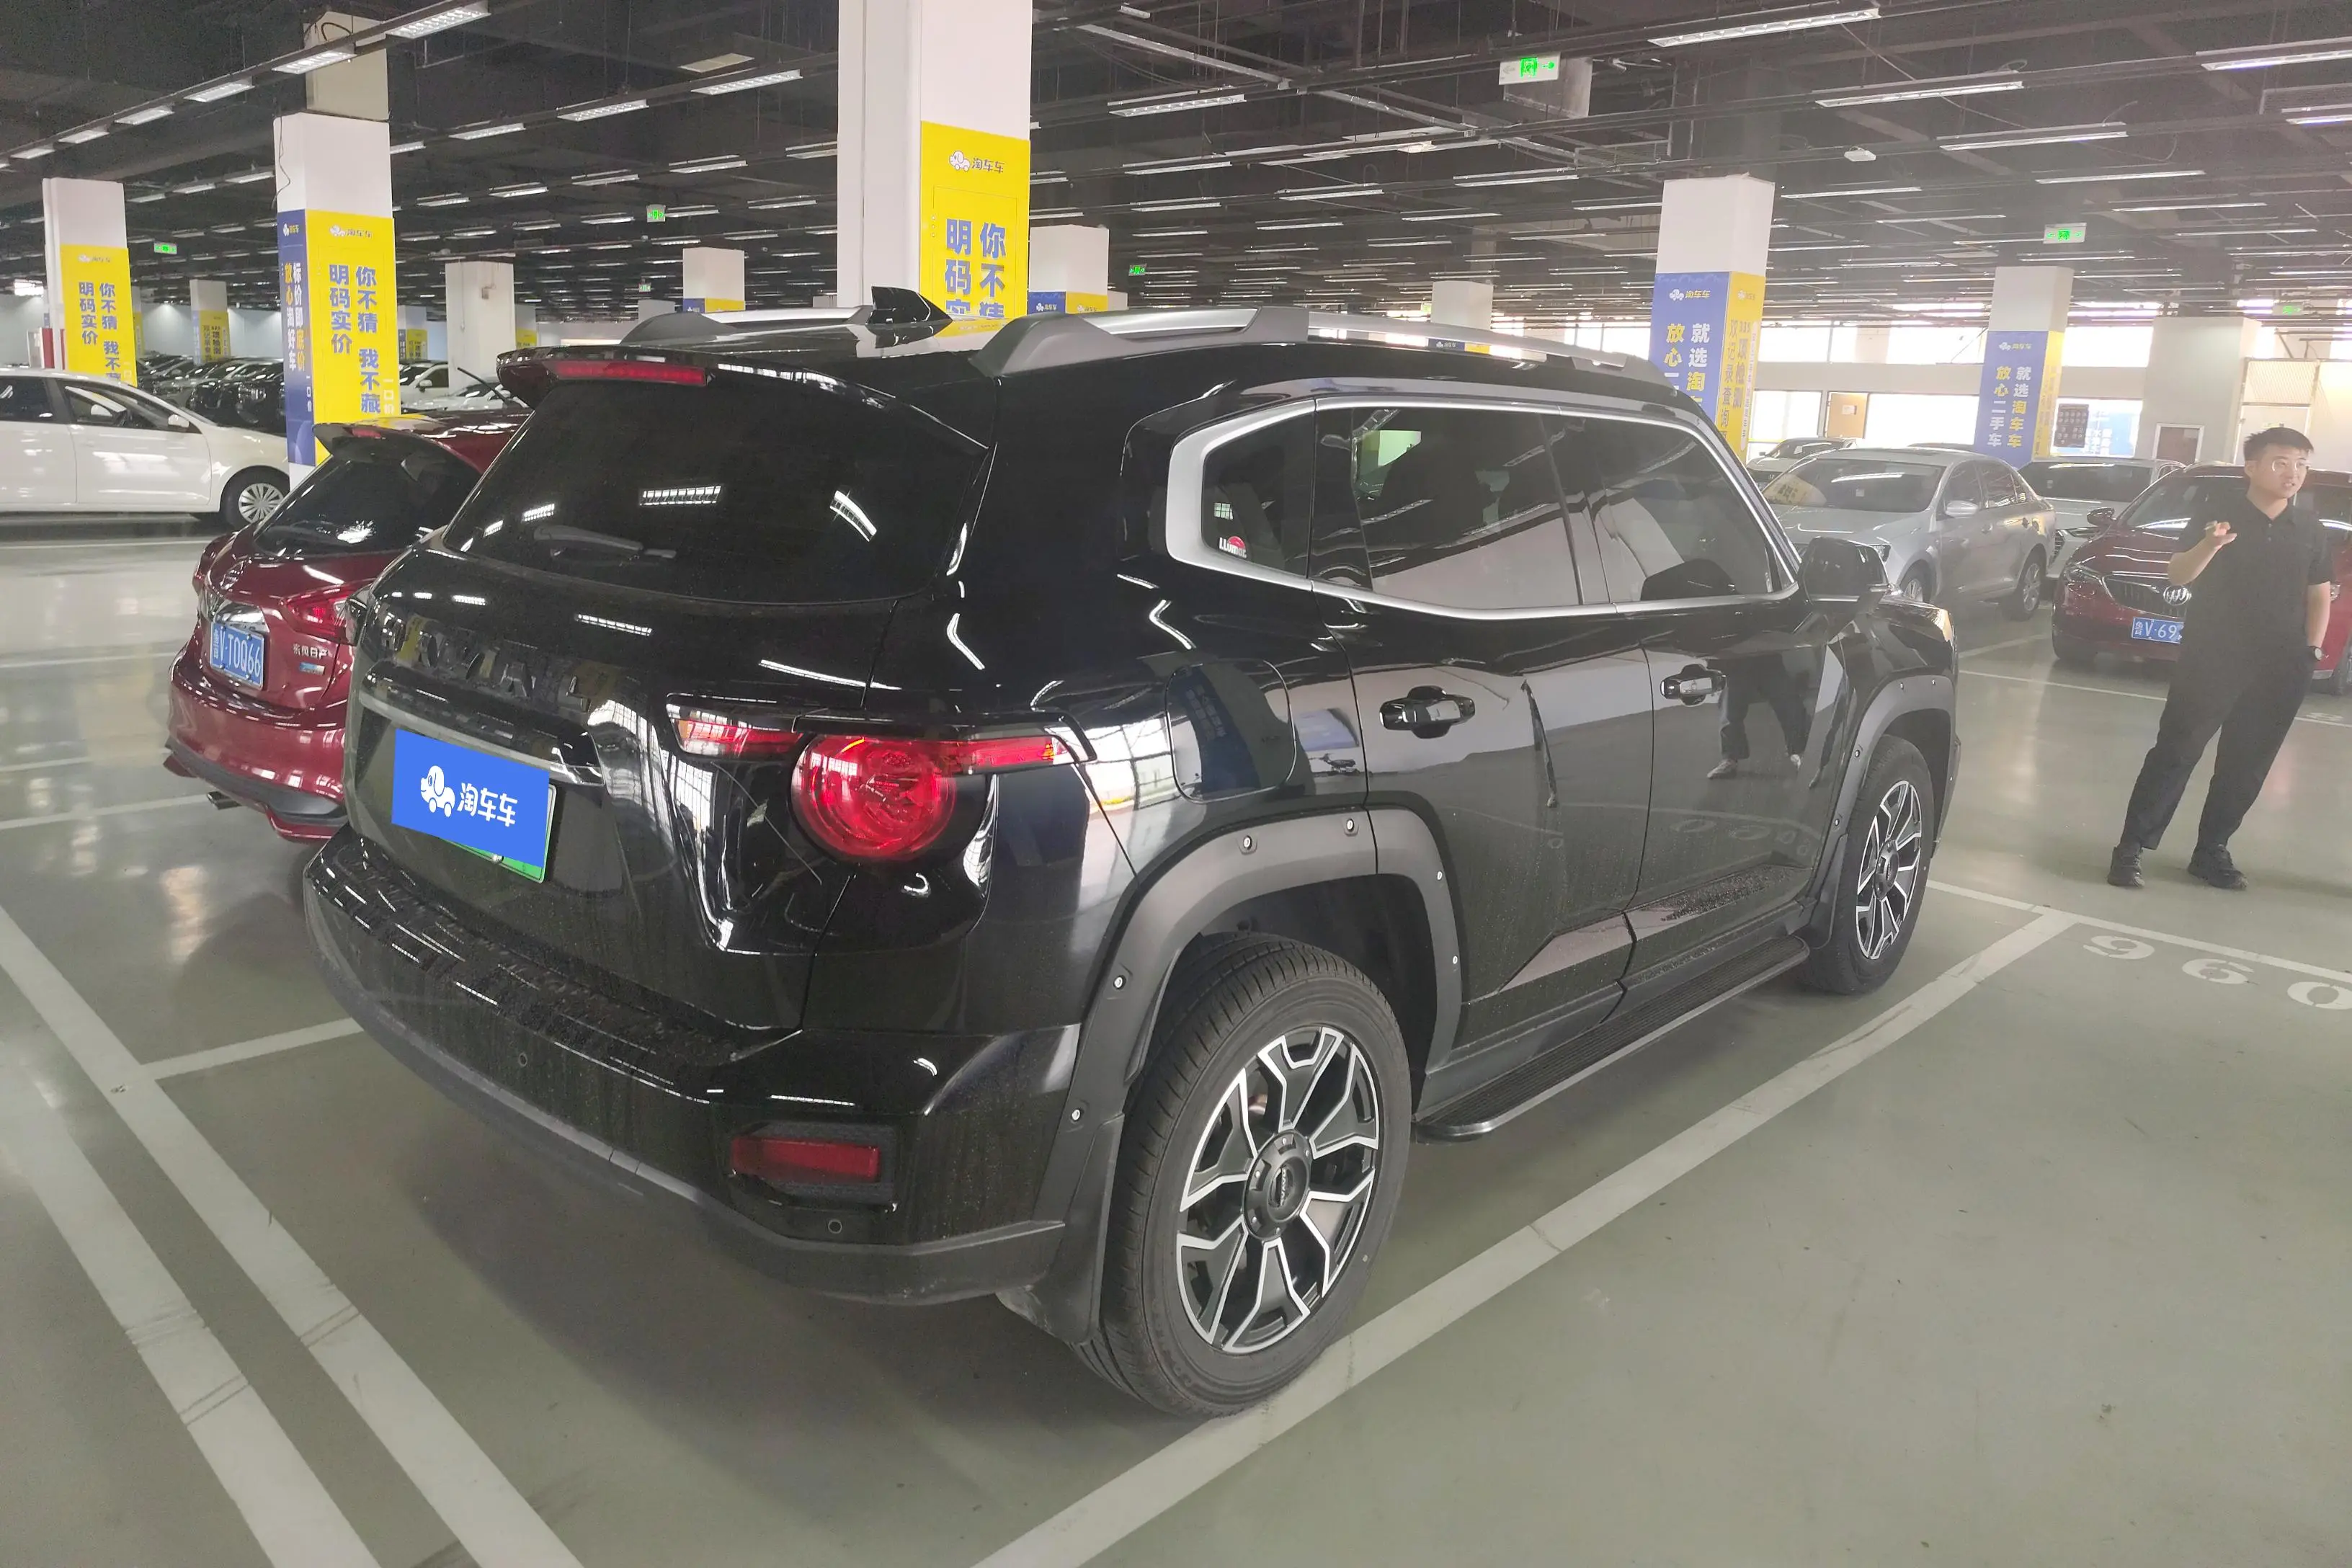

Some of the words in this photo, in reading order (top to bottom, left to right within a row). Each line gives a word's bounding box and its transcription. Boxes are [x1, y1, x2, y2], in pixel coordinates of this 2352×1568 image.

[971, 157, 1005, 174] 淘车车
[79, 281, 98, 345] 明码实价
[99, 282, 117, 330] 你不猜
[329, 264, 352, 355] 明码实价
[355, 266, 378, 333] 你不猜
[1685, 290, 1711, 299] 淘车车
[359, 349, 380, 414] 我不藏
[1987, 365, 2011, 447] 放心二手车
[2007, 366, 2031, 447] 就选淘车车
[2134, 620, 2183, 642] 鲁V·69
